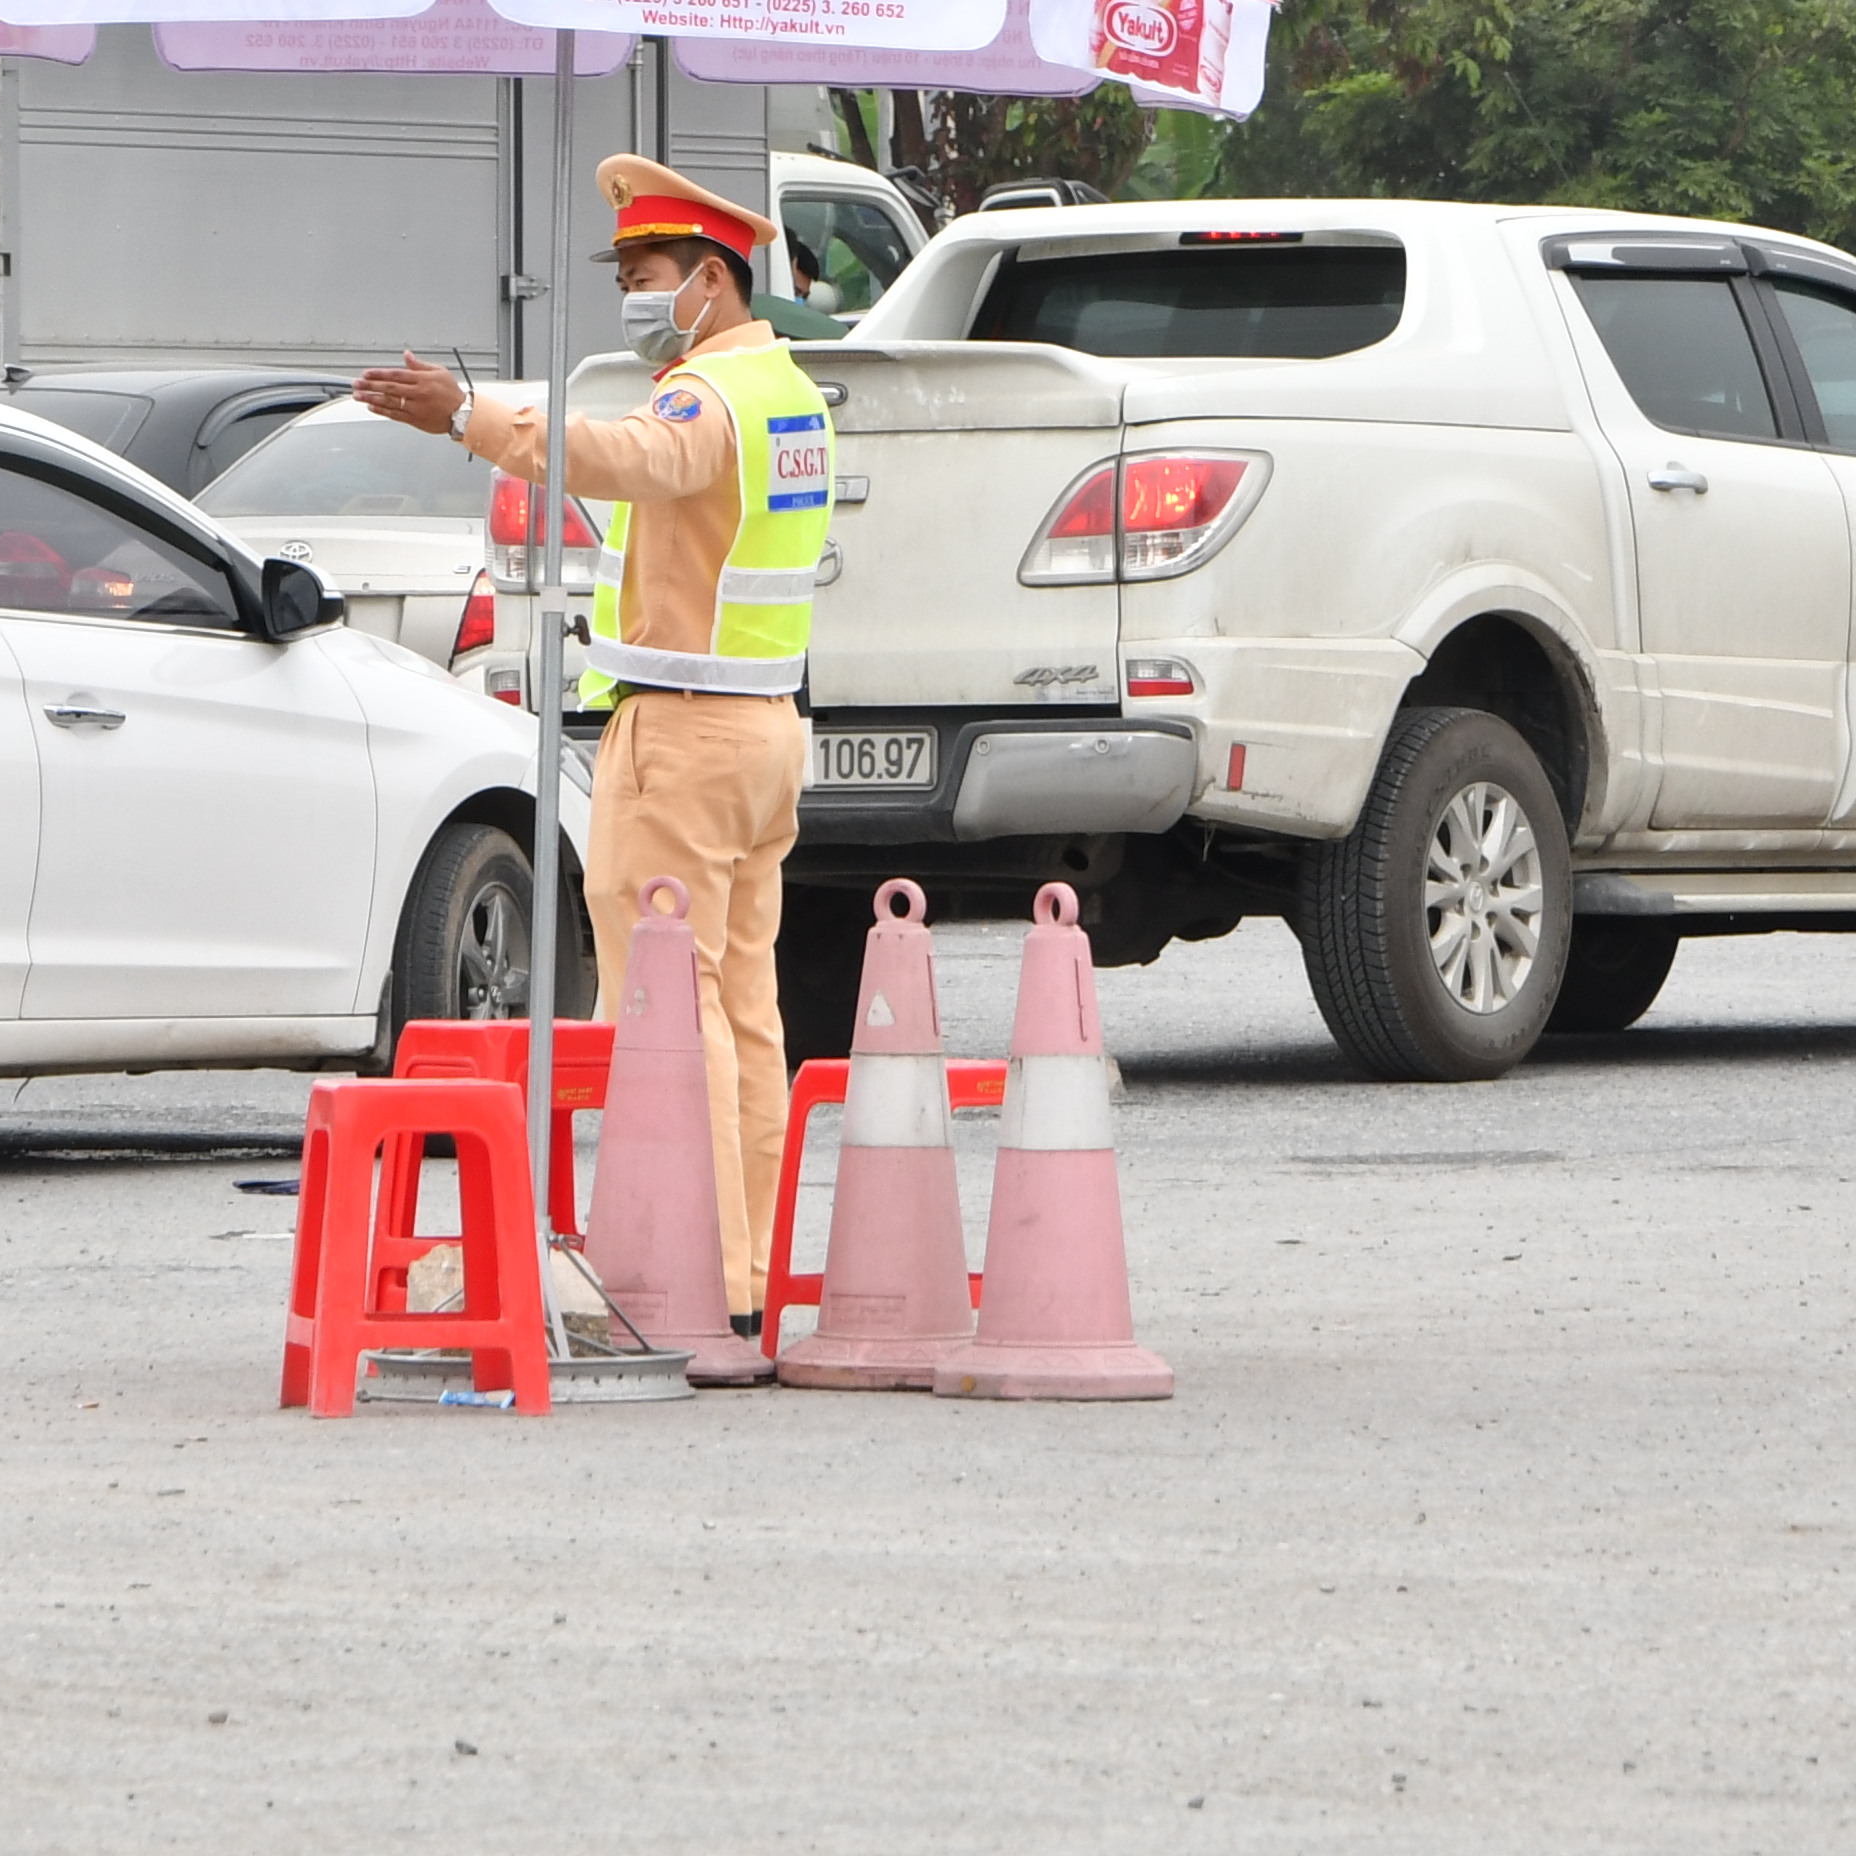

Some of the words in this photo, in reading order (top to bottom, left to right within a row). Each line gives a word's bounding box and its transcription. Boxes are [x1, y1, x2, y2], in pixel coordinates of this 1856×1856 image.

[642, 10, 714, 28] Website:
[720, 14, 846, 36] Http://yakult.vn
[821, 0, 835, 15] 3.
[841, 1, 870, 17] 260
[875, 3, 904, 19] 652
[1117, 11, 1165, 44] Yakult
[777, 447, 826, 479] C.S.G.T
[819, 736, 925, 780] 106.97
